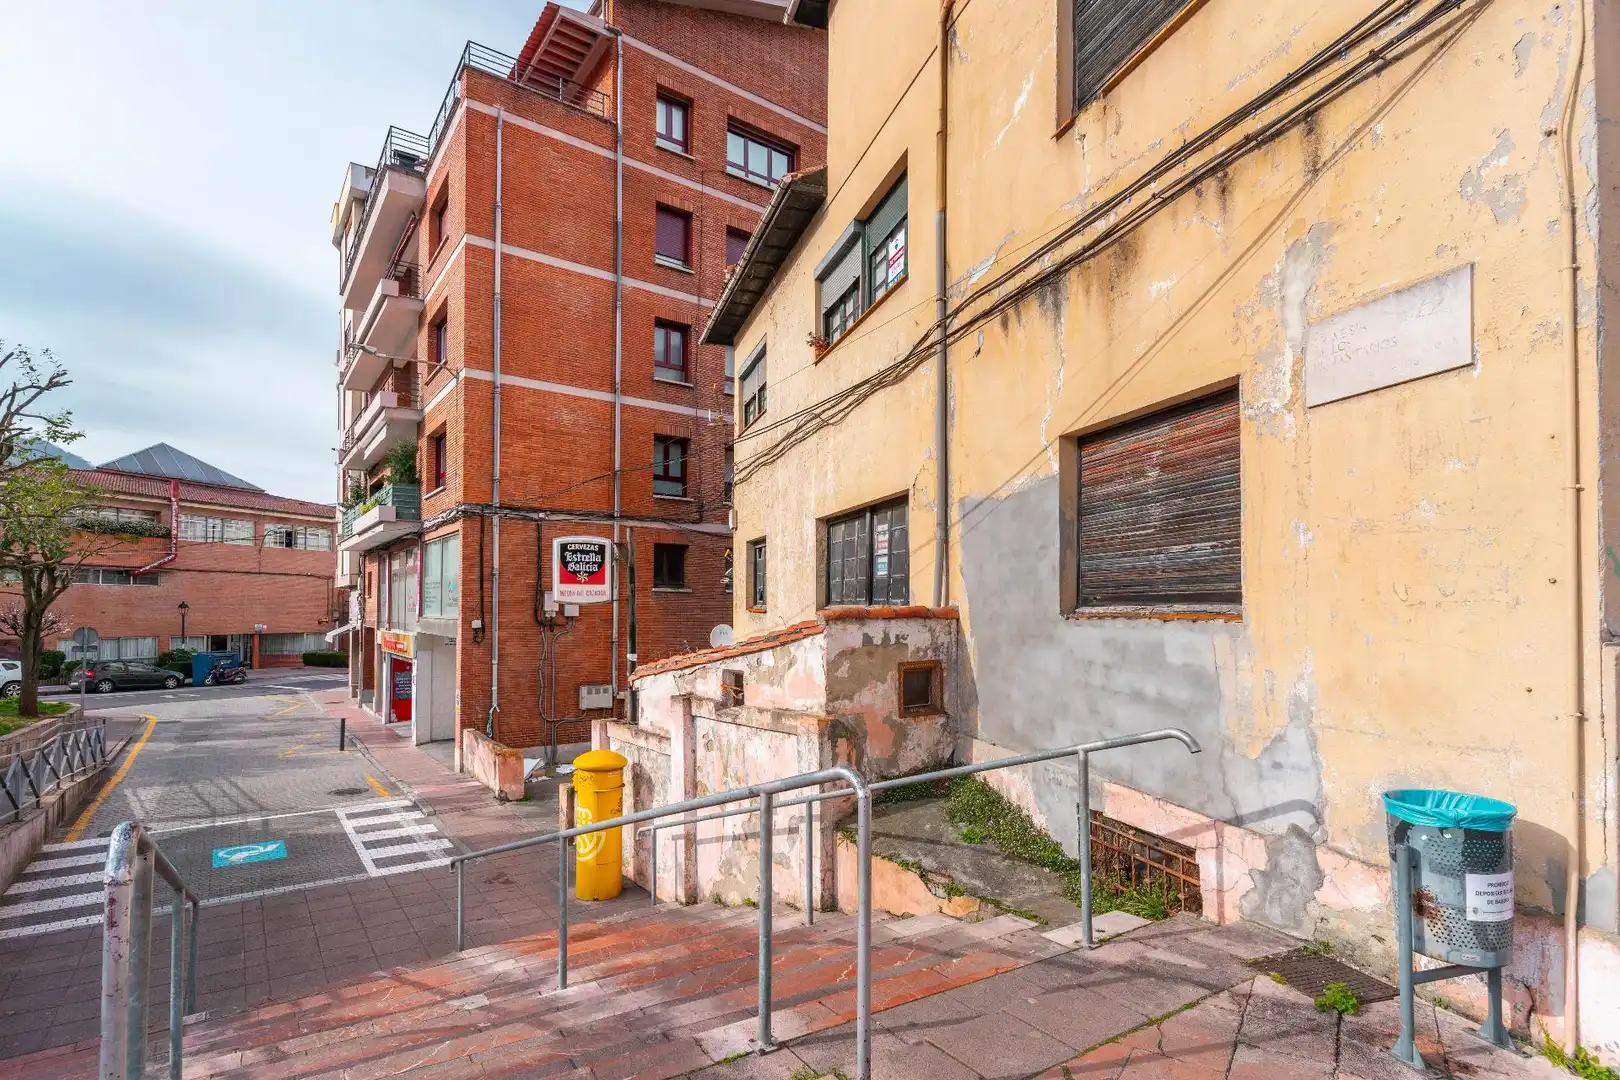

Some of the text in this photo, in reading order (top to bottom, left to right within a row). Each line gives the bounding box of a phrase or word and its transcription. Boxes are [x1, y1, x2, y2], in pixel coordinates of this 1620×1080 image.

[567, 543, 599, 551] CERVEZAS
[564, 551, 602, 562] Estrella
[567, 561, 599, 572] Galicia
